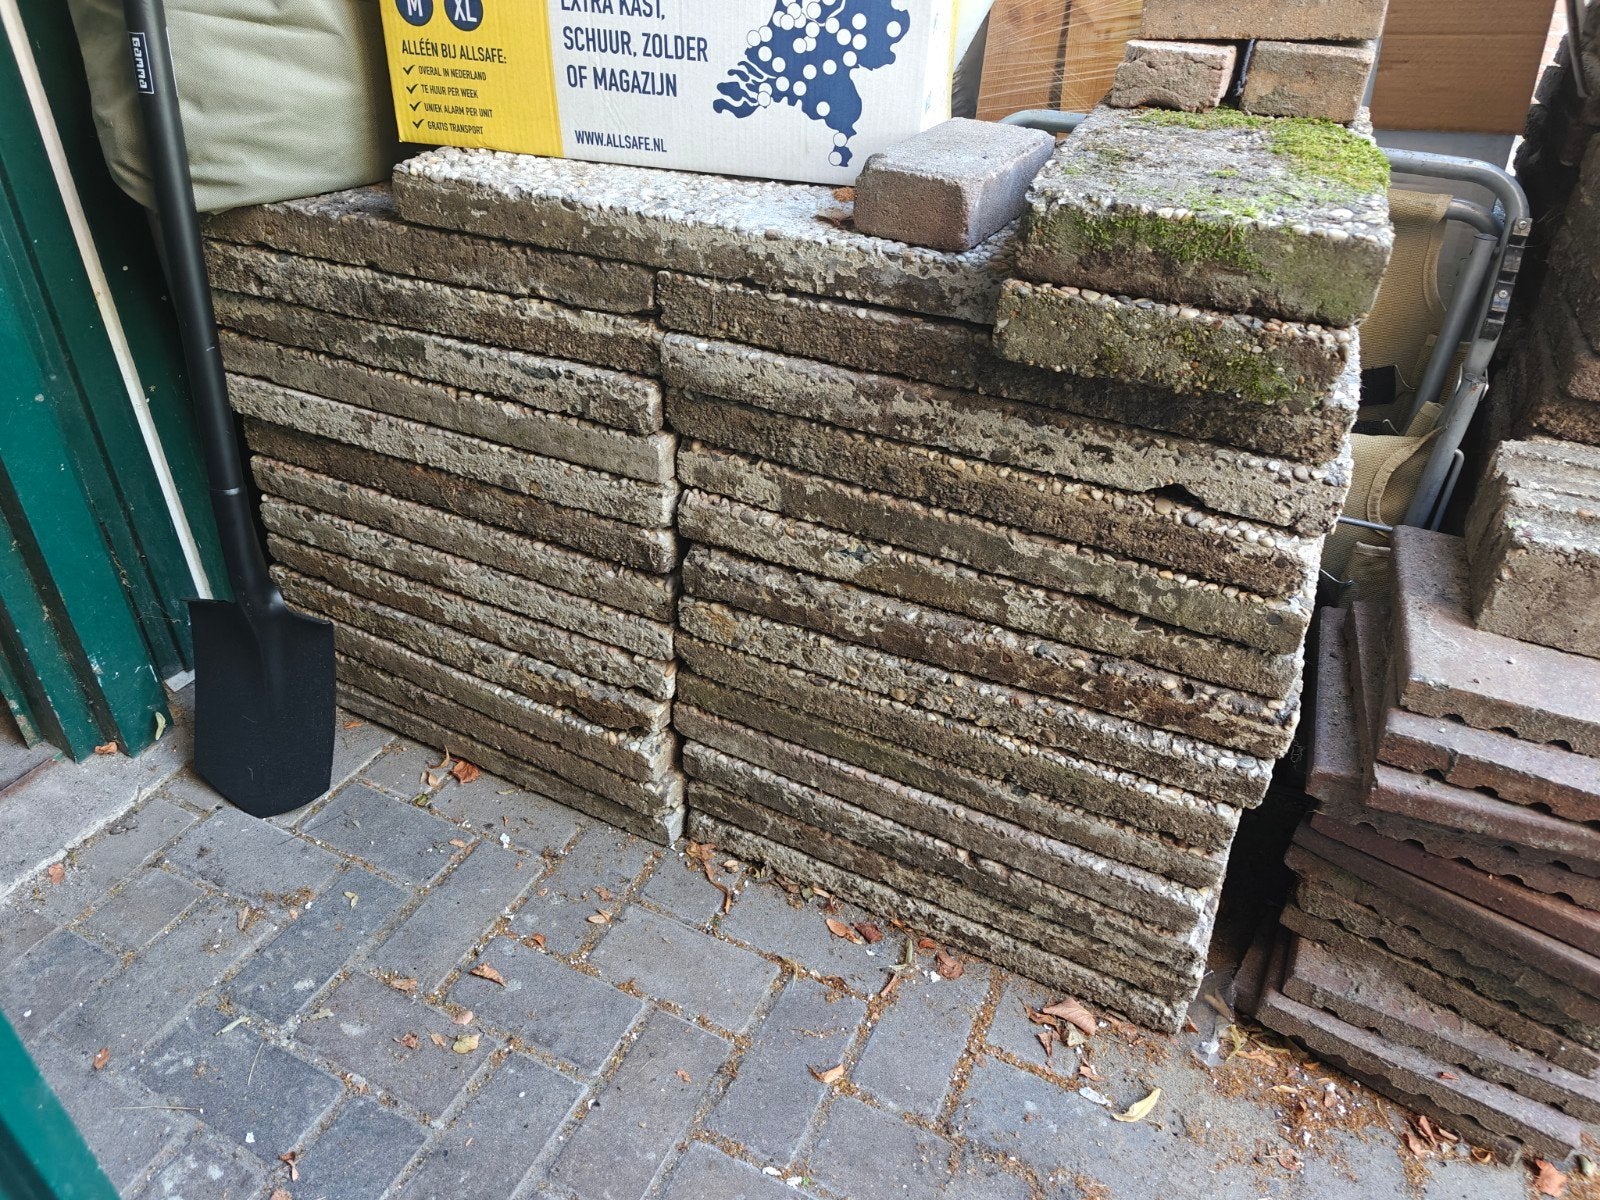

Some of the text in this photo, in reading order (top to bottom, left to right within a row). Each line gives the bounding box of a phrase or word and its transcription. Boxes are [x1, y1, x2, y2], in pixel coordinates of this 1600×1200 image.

[454, 0, 478, 23] XL
[619, 0, 665, 20] KAST,
[402, 37, 507, 64] ALLÉÉN BIJ ALLSAFE:
[563, 25, 709, 62] SCHUUR, ZOLDER
[418, 65, 487, 81] OVERAL IN NEDERLAND
[566, 64, 678, 97] OF MAGAZIJN
[421, 84, 479, 99] TE HUUR PER WEEK
[424, 102, 493, 118] UNIEK ALARM PER UNIT
[427, 120, 484, 135] GRATIS TRANSPORT
[574, 130, 668, 153] WWW.ALLSAFE.NL
